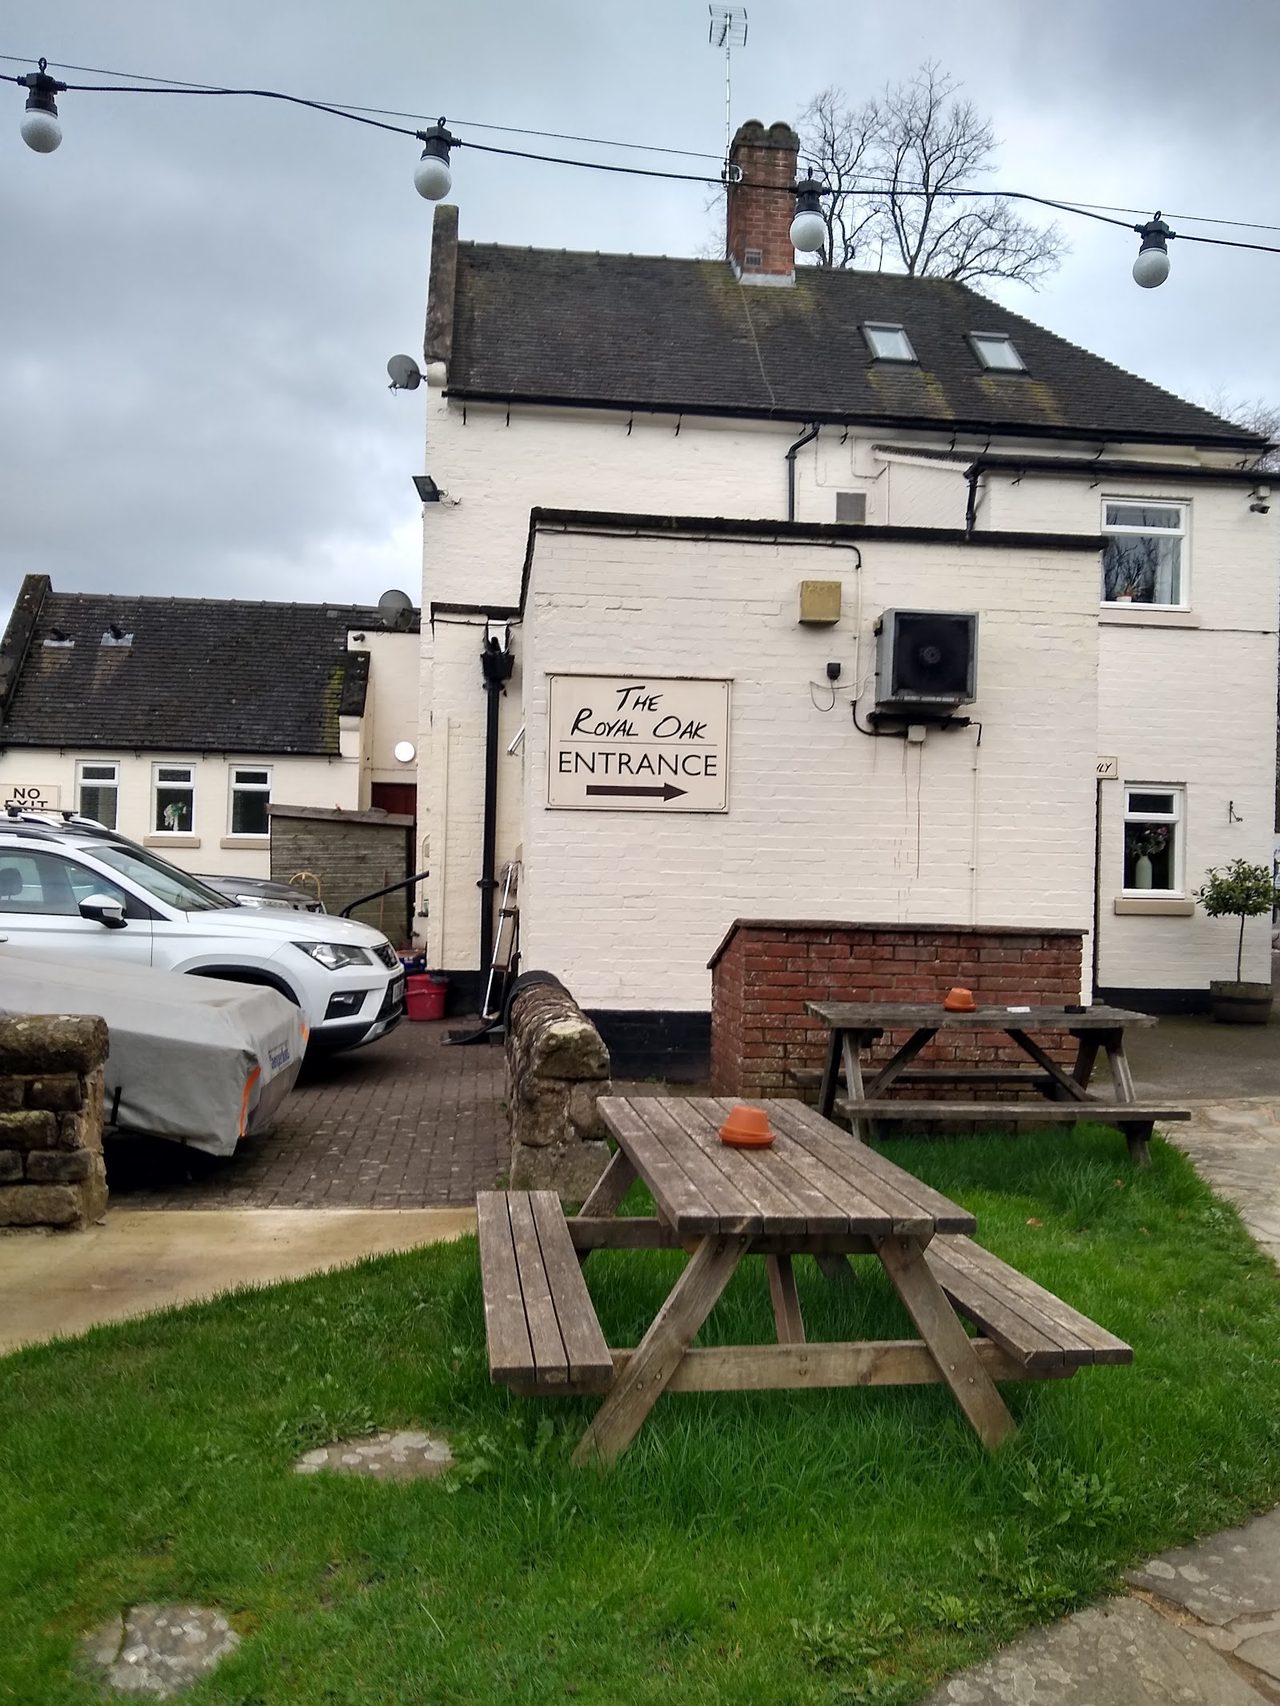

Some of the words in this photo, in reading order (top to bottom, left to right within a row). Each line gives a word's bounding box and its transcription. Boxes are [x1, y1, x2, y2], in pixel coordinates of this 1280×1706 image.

[616, 685, 664, 712] THE
[570, 708, 639, 736] ROYAL
[652, 715, 708, 740] OAK
[558, 751, 718, 777] ENTRANCE
[13, 787, 41, 799] NO
